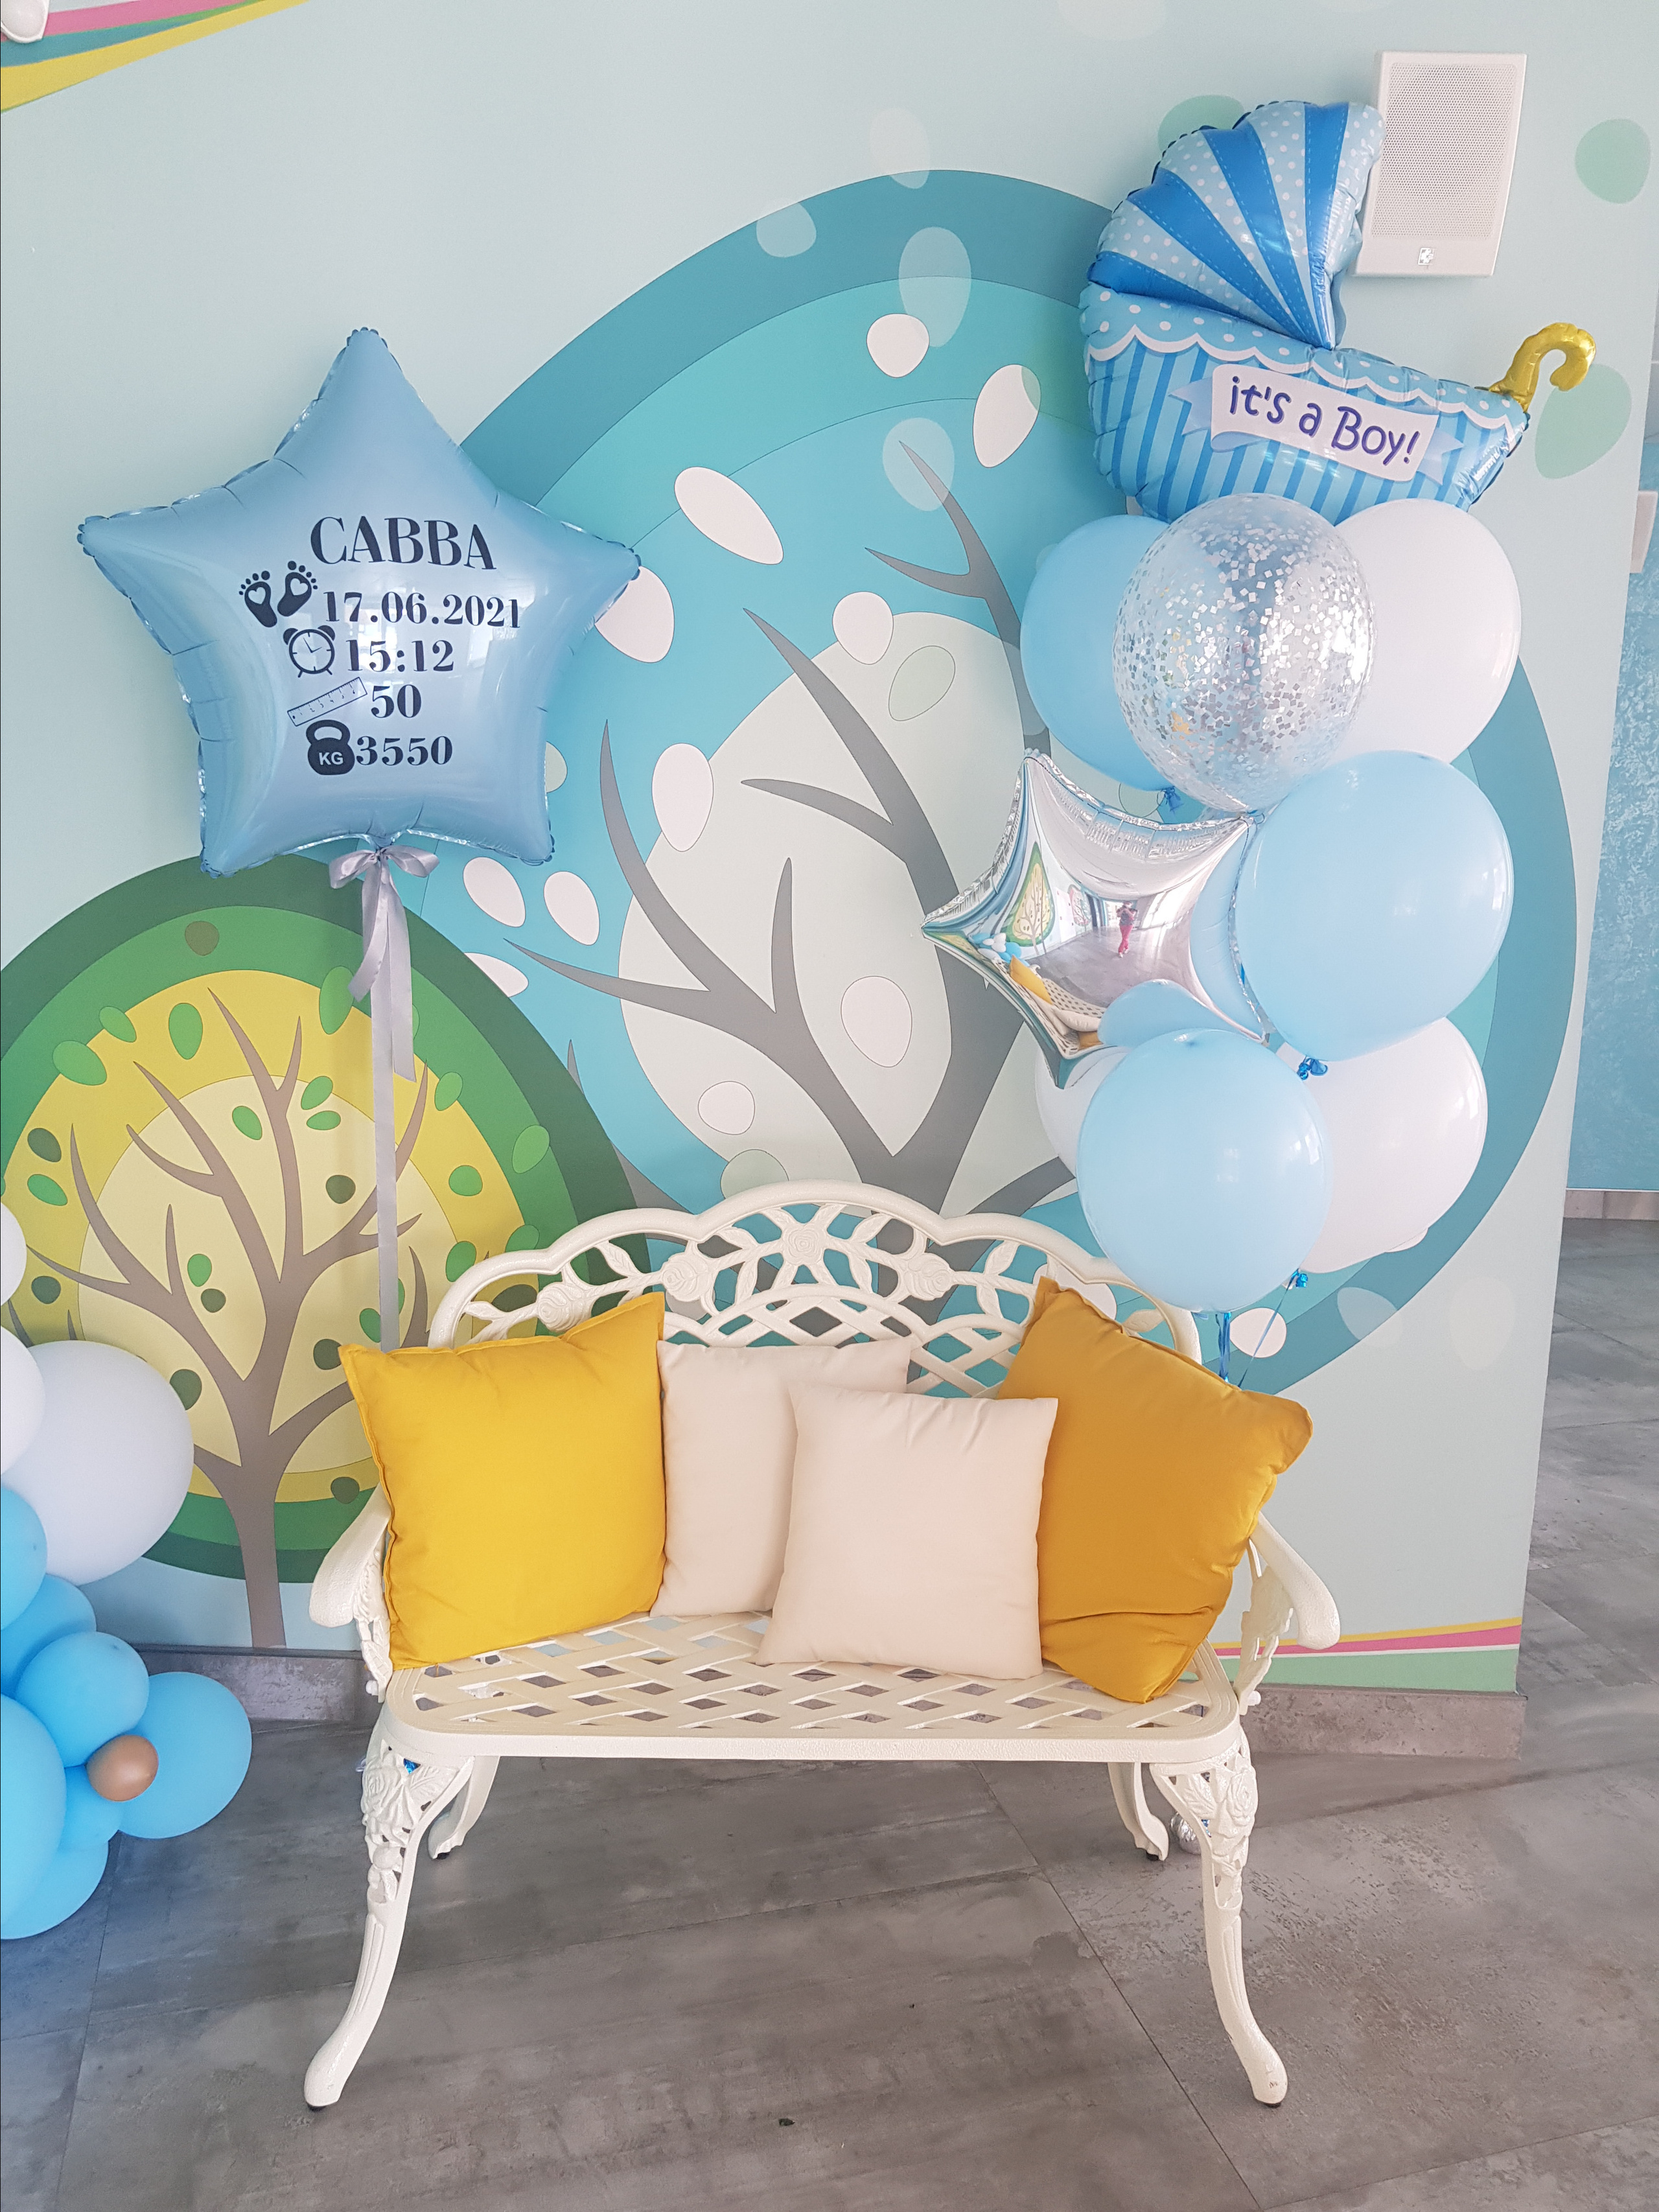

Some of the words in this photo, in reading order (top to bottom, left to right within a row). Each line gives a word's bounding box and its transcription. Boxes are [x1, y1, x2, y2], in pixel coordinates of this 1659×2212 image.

[1230, 375, 1292, 425] it's
[1299, 402, 1322, 437] a
[1331, 406, 1421, 466] Boy!
[323, 591, 520, 628] 17.06.2021
[345, 639, 455, 672] 15:12
[371, 684, 423, 719] 50
[318, 751, 344, 765] KG
[355, 735, 453, 767] 3550
